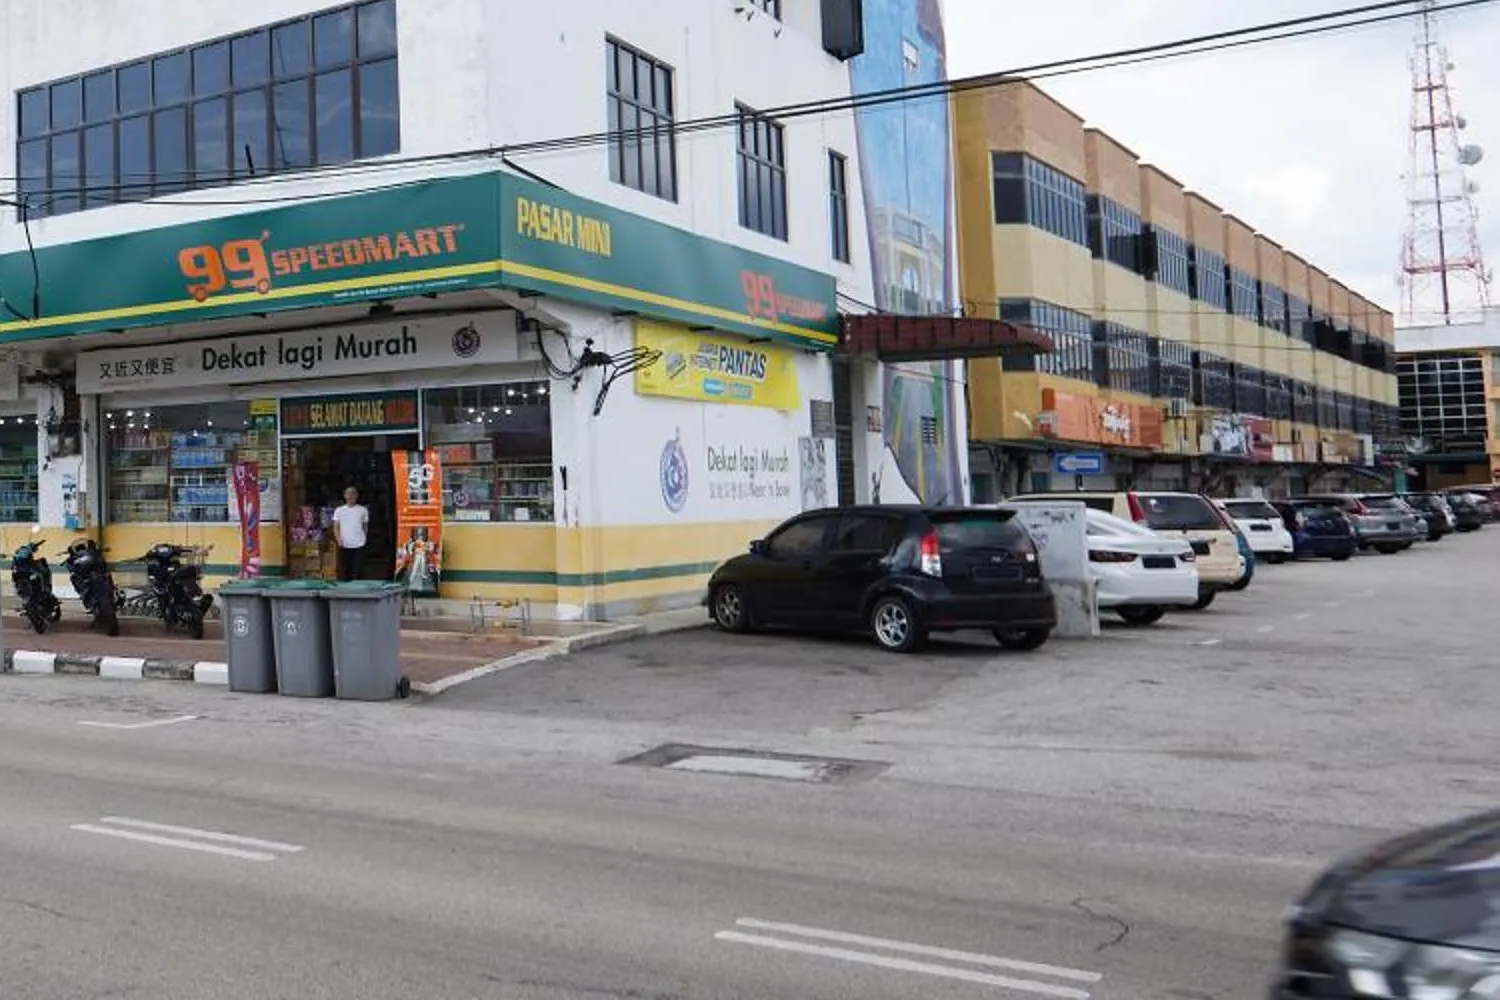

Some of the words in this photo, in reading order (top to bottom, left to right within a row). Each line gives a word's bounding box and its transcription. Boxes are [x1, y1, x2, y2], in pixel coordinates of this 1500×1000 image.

[517, 197, 575, 248] PASAR
[576, 215, 611, 257] MINI
[178, 239, 270, 302] 99
[271, 224, 457, 275] SPEEDMART
[740, 270, 776, 322] 99
[202, 344, 267, 371] Dekat
[278, 338, 323, 370] lagi
[335, 326, 418, 361] Murah
[719, 345, 768, 379] PANTAS
[408, 463, 435, 488] 5G
[707, 445, 737, 472] Dekat
[740, 444, 758, 479] lagi
[761, 447, 789, 473] Murah
